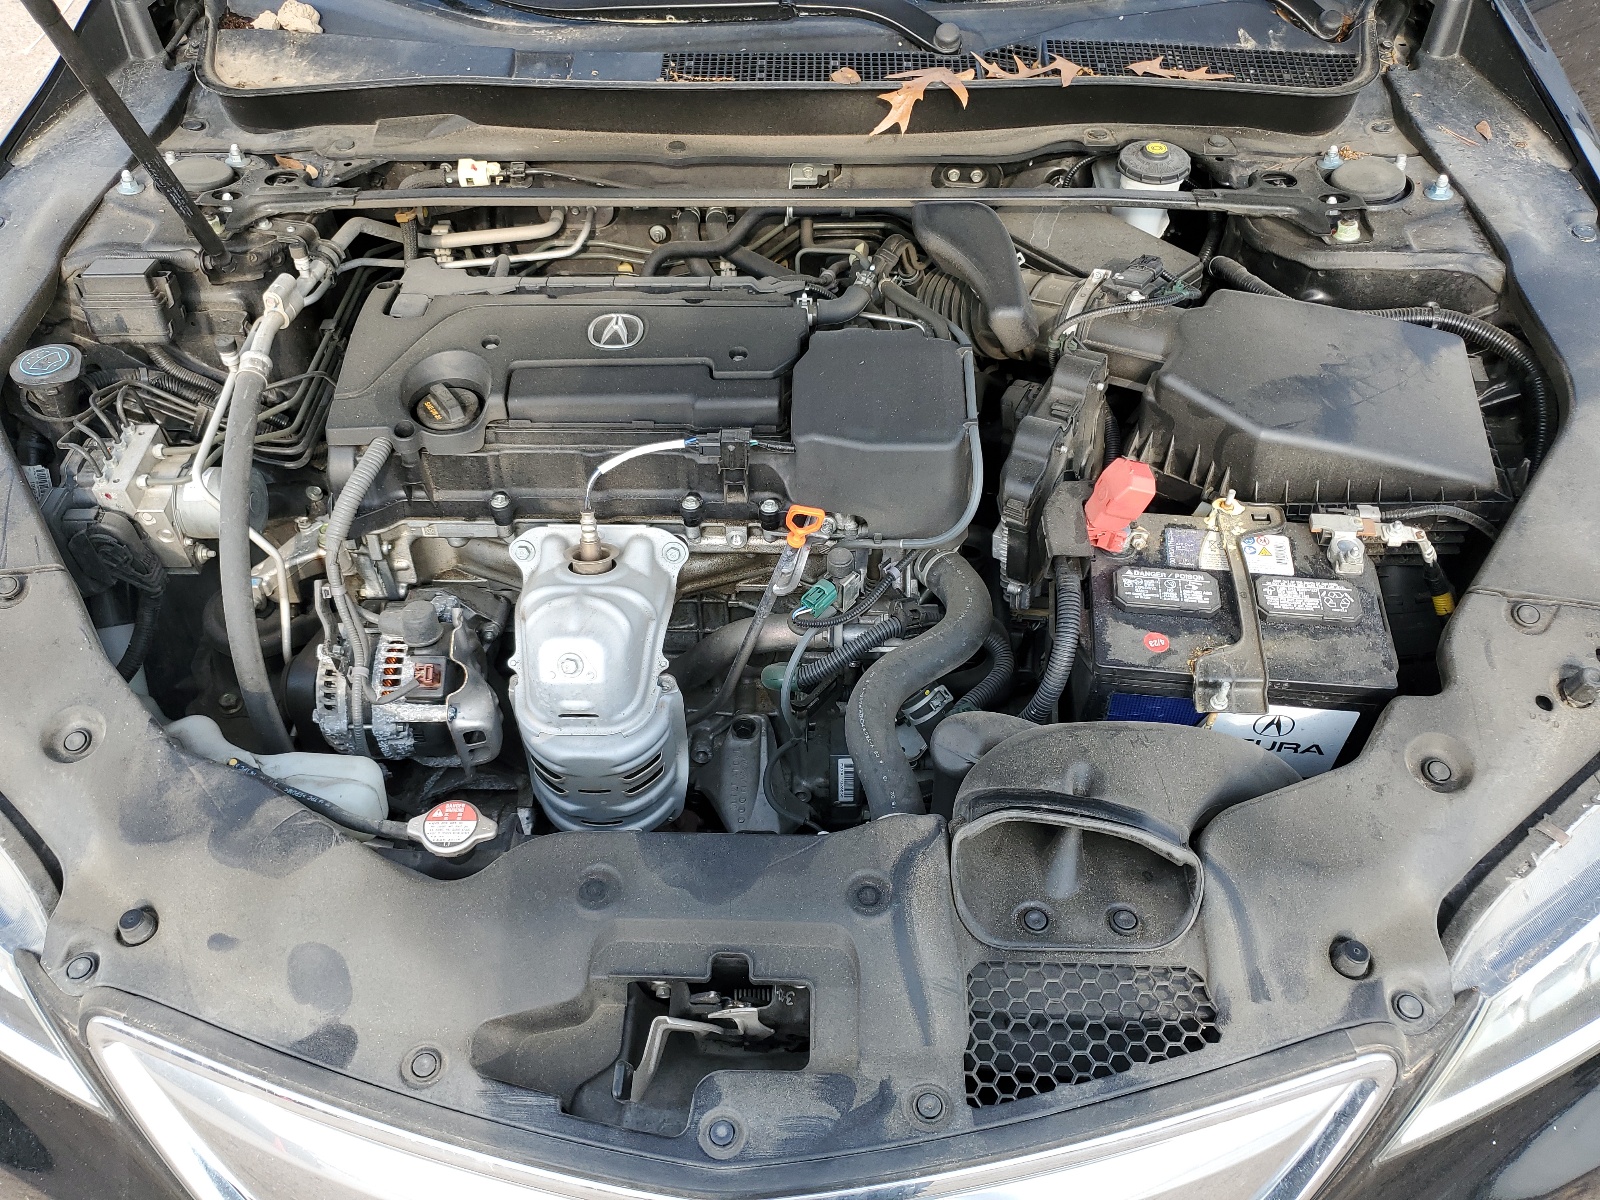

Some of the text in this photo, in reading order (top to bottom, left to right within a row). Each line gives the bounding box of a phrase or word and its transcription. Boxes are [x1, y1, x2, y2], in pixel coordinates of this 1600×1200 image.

[1133, 569, 1167, 578] DANGER
[1174, 573, 1205, 581] POISON
[1243, 738, 1325, 756] URA
